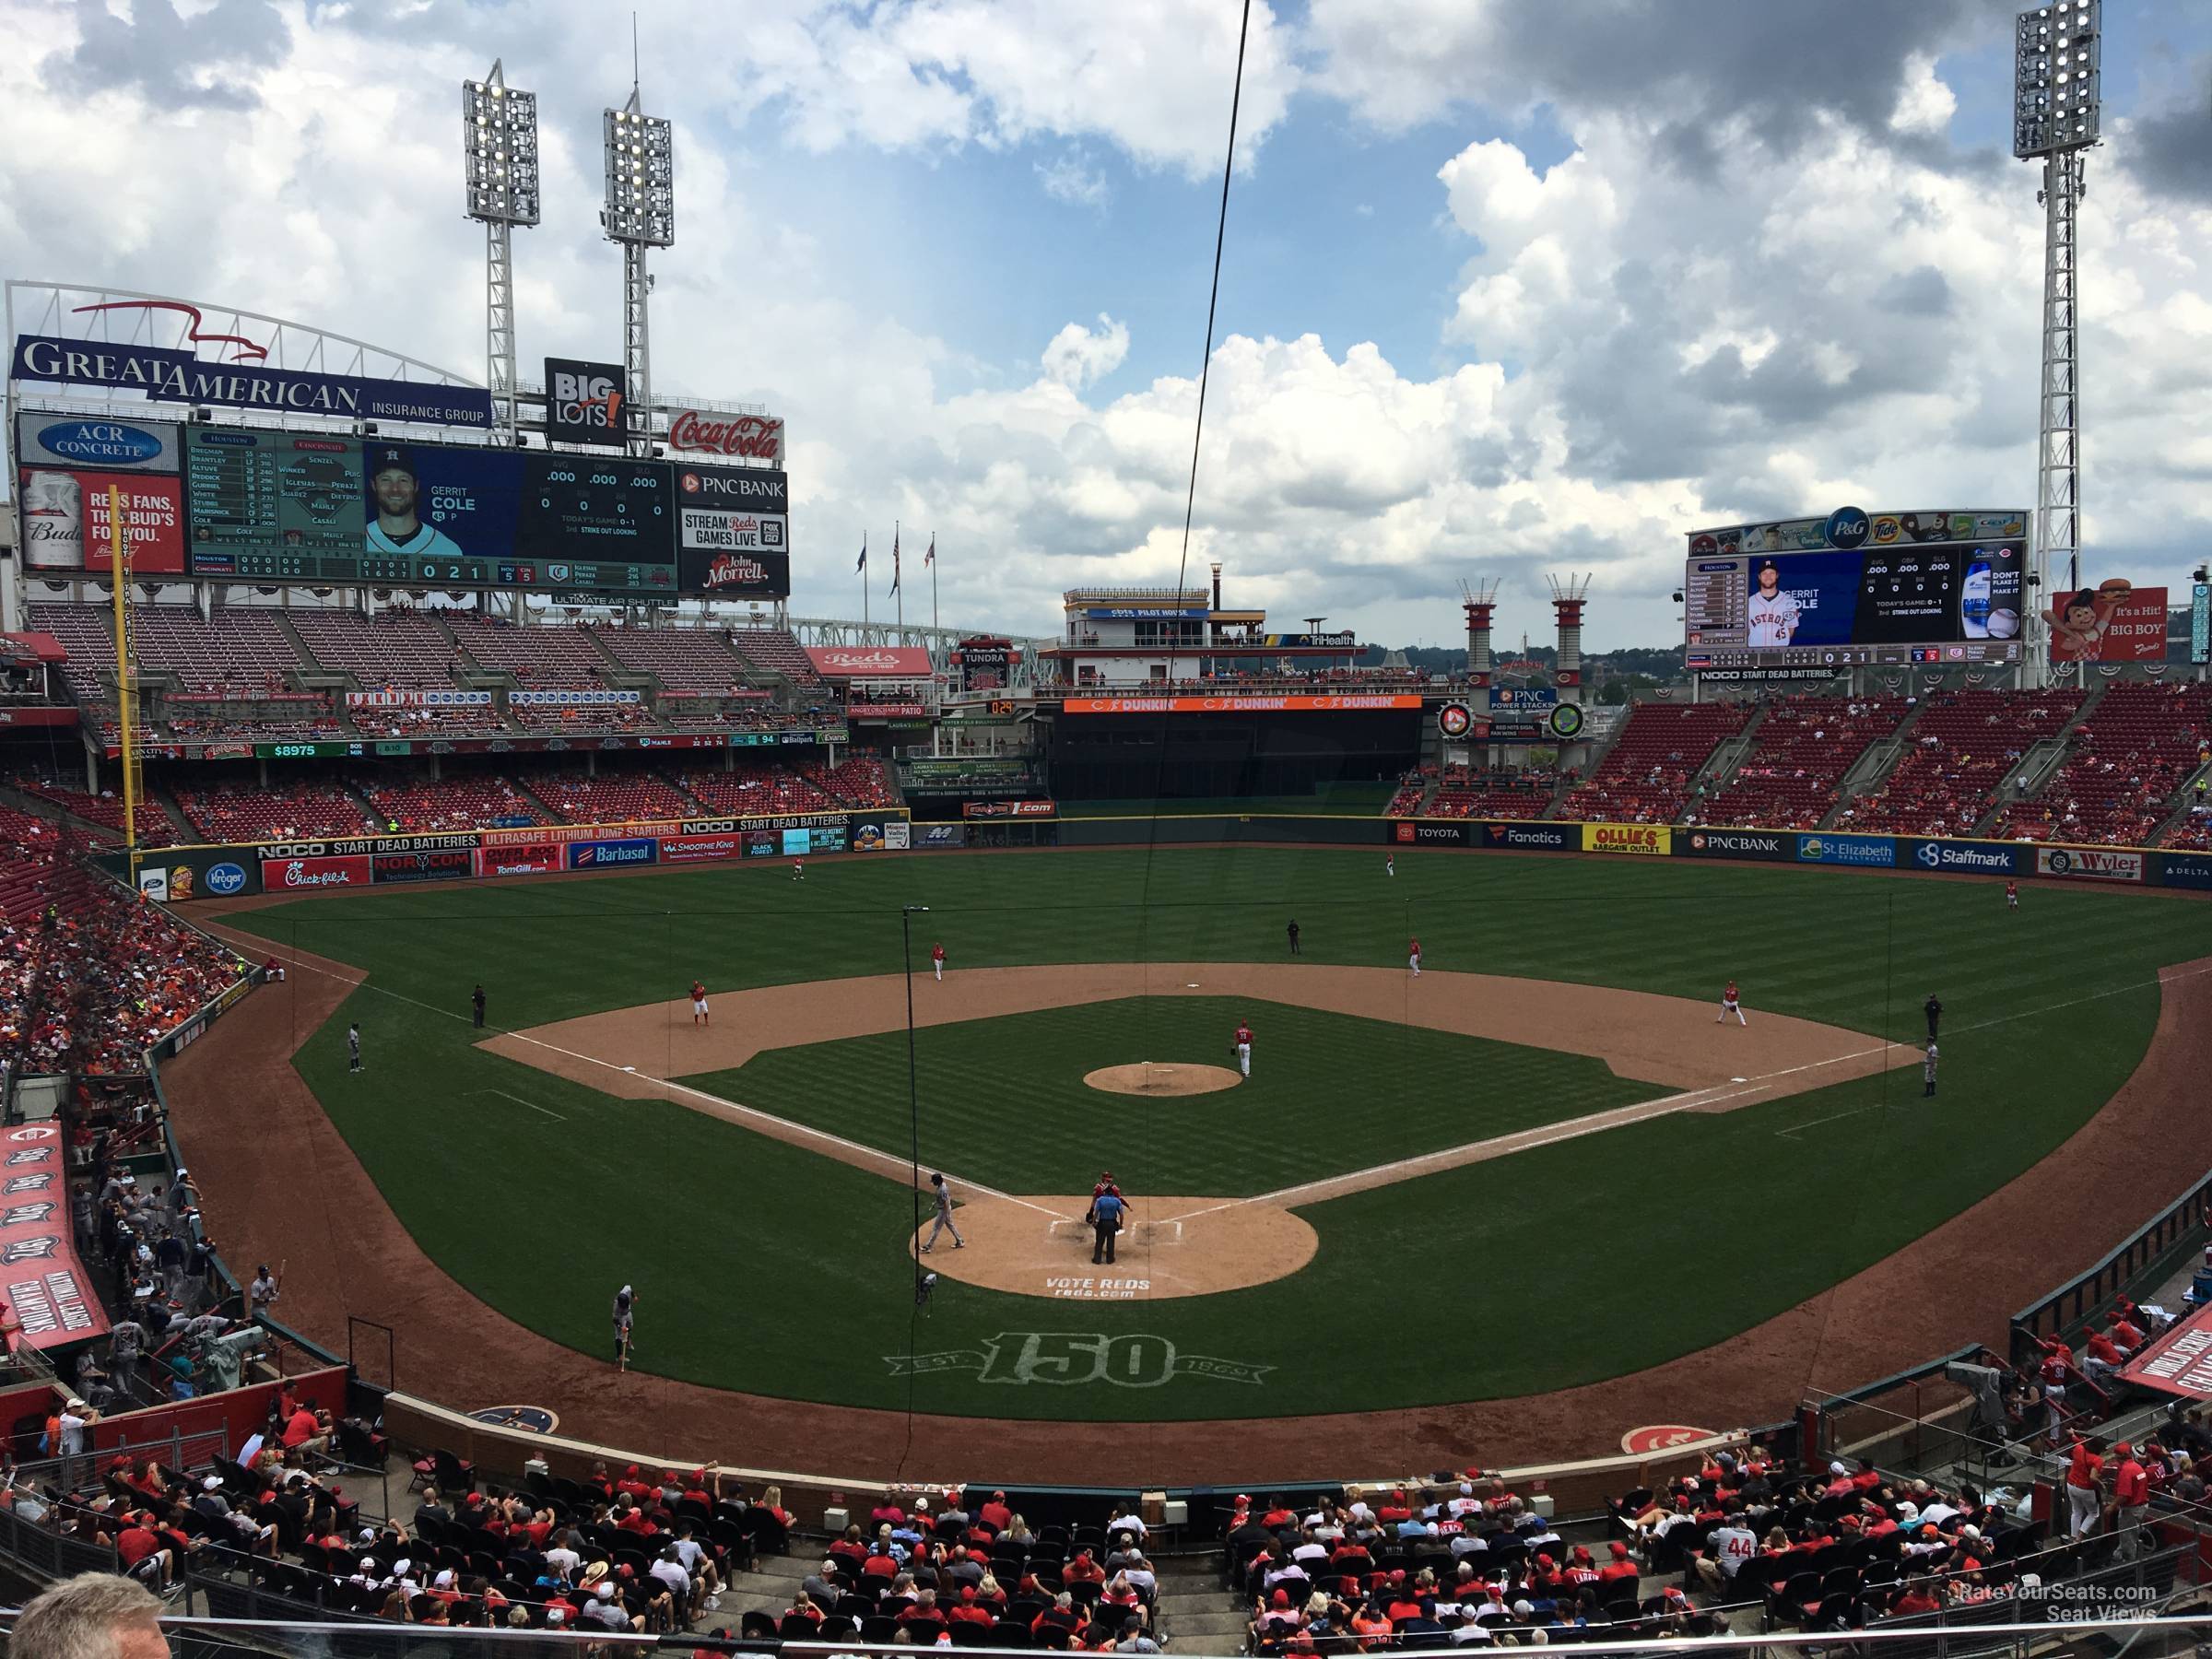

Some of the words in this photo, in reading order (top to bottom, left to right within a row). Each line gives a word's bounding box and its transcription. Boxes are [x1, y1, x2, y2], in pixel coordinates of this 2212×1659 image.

[23, 340, 168, 384] GREAT
[159, 365, 360, 413] AMERICAN
[555, 372, 616, 402] BIG
[371, 401, 443, 419] INSURANCE
[445, 406, 484, 422] GROUP
[556, 391, 622, 429] LOTS!
[76, 425, 124, 442] ACR
[670, 412, 783, 458] Coca-Cola
[56, 441, 142, 457] CONCRETE
[286, 479, 316, 488] IGLESIAS
[547, 471, 575, 482] .000
[589, 474, 617, 485] .000
[630, 477, 657, 488] .000
[701, 477, 738, 494] PNC
[738, 479, 784, 497] BANK
[430, 486, 467, 497] GERRIT
[90, 493, 129, 507] RES
[134, 496, 174, 512] FANS,
[431, 497, 476, 512] COLE
[90, 510, 124, 524] THS
[130, 512, 174, 526] BUD'S
[686, 514, 728, 530] STREAM
[729, 516, 758, 531] Reds
[128, 528, 159, 542] YOU.
[763, 523, 779, 532] FOX
[1835, 520, 1865, 535] P&G
[1874, 520, 1898, 540] Tide
[696, 530, 733, 545] GAMES
[735, 533, 757, 546] LIVE
[727, 556, 752, 569] John
[450, 566, 459, 578] 2
[703, 562, 769, 588] Morrell
[555, 595, 606, 606] ULTIMATE
[1784, 589, 1819, 598] GERRIT
[2117, 607, 2132, 616] It's
[2141, 606, 2161, 615] Hit!
[1775, 628, 1786, 640] 45
[2111, 625, 2132, 635] BIG
[2136, 624, 2161, 635] BOY
[1310, 635, 1354, 646] TriHealth
[824, 652, 900, 666] Reds
[965, 654, 1004, 663] TUNDRA
[1843, 653, 1851, 663] 2
[1701, 671, 1739, 680] NOCO
[1742, 671, 1766, 679] START
[1768, 670, 1789, 678] DEAD
[1123, 699, 1177, 710] DUNKIN'
[1234, 698, 1287, 709] DUNKIN'
[1342, 696, 1395, 707] DUNKIN'
[1514, 690, 1545, 702] PNC
[901, 707, 921, 716] PATIO
[992, 703, 1012, 714] 0:29
[824, 733, 846, 741] Evans
[275, 745, 315, 757] $8975
[683, 820, 735, 834] NOCO
[740, 818, 771, 830] START
[773, 816, 797, 828] DEAD
[800, 814, 851, 827] BATTERIES.
[486, 833, 547, 845] ULTRASAFE
[551, 829, 593, 841] LITHIUM
[596, 827, 623, 839] JUMP
[627, 823, 679, 837] STARTERS.
[1418, 829, 1459, 838] TOYOTA
[1508, 830, 1562, 844] Fanatics
[1596, 828, 1657, 846] OLLIE'S
[258, 843, 325, 859] NOCO
[334, 841, 373, 854] START
[377, 838, 410, 852] DEAD
[414, 835, 479, 850] BATTERIES.
[678, 841, 715, 851] SMOOTHIE
[715, 841, 735, 849] KING
[1593, 843, 1627, 852] BARGAIN
[1708, 836, 1739, 849] PNC
[1740, 837, 1779, 852] BANK
[1823, 842, 1837, 854] St.
[1839, 843, 1892, 858] Elizabeth
[596, 846, 648, 862] Barbasol
[1942, 849, 2010, 867] Staffmark
[496, 864, 546, 874] TomGill.com
[2054, 857, 2064, 867] 45
[2080, 853, 2137, 873] Wyler
[211, 868, 241, 889] Kroger
[286, 863, 350, 886] Chick-fil-A
[386, 872, 426, 881] Technology
[2177, 867, 2209, 876] DELTA
[9, 1238, 52, 1260] 1972
[45, 1271, 80, 1304] NATIONAL
[1046, 1277, 1100, 1290] VOTE
[1103, 1278, 1151, 1290] REDS
[1054, 1289, 1135, 1299] reds.com
[9, 1280, 57, 1335] CHAMPIONS
[58, 1301, 92, 1331] LEAGUE
[976, 1332, 1176, 1387] 150
[1187, 1359, 1249, 1376] 1869
[2141, 1351, 2193, 1379] WORLD
[1728, 1537, 1752, 1558] 44
